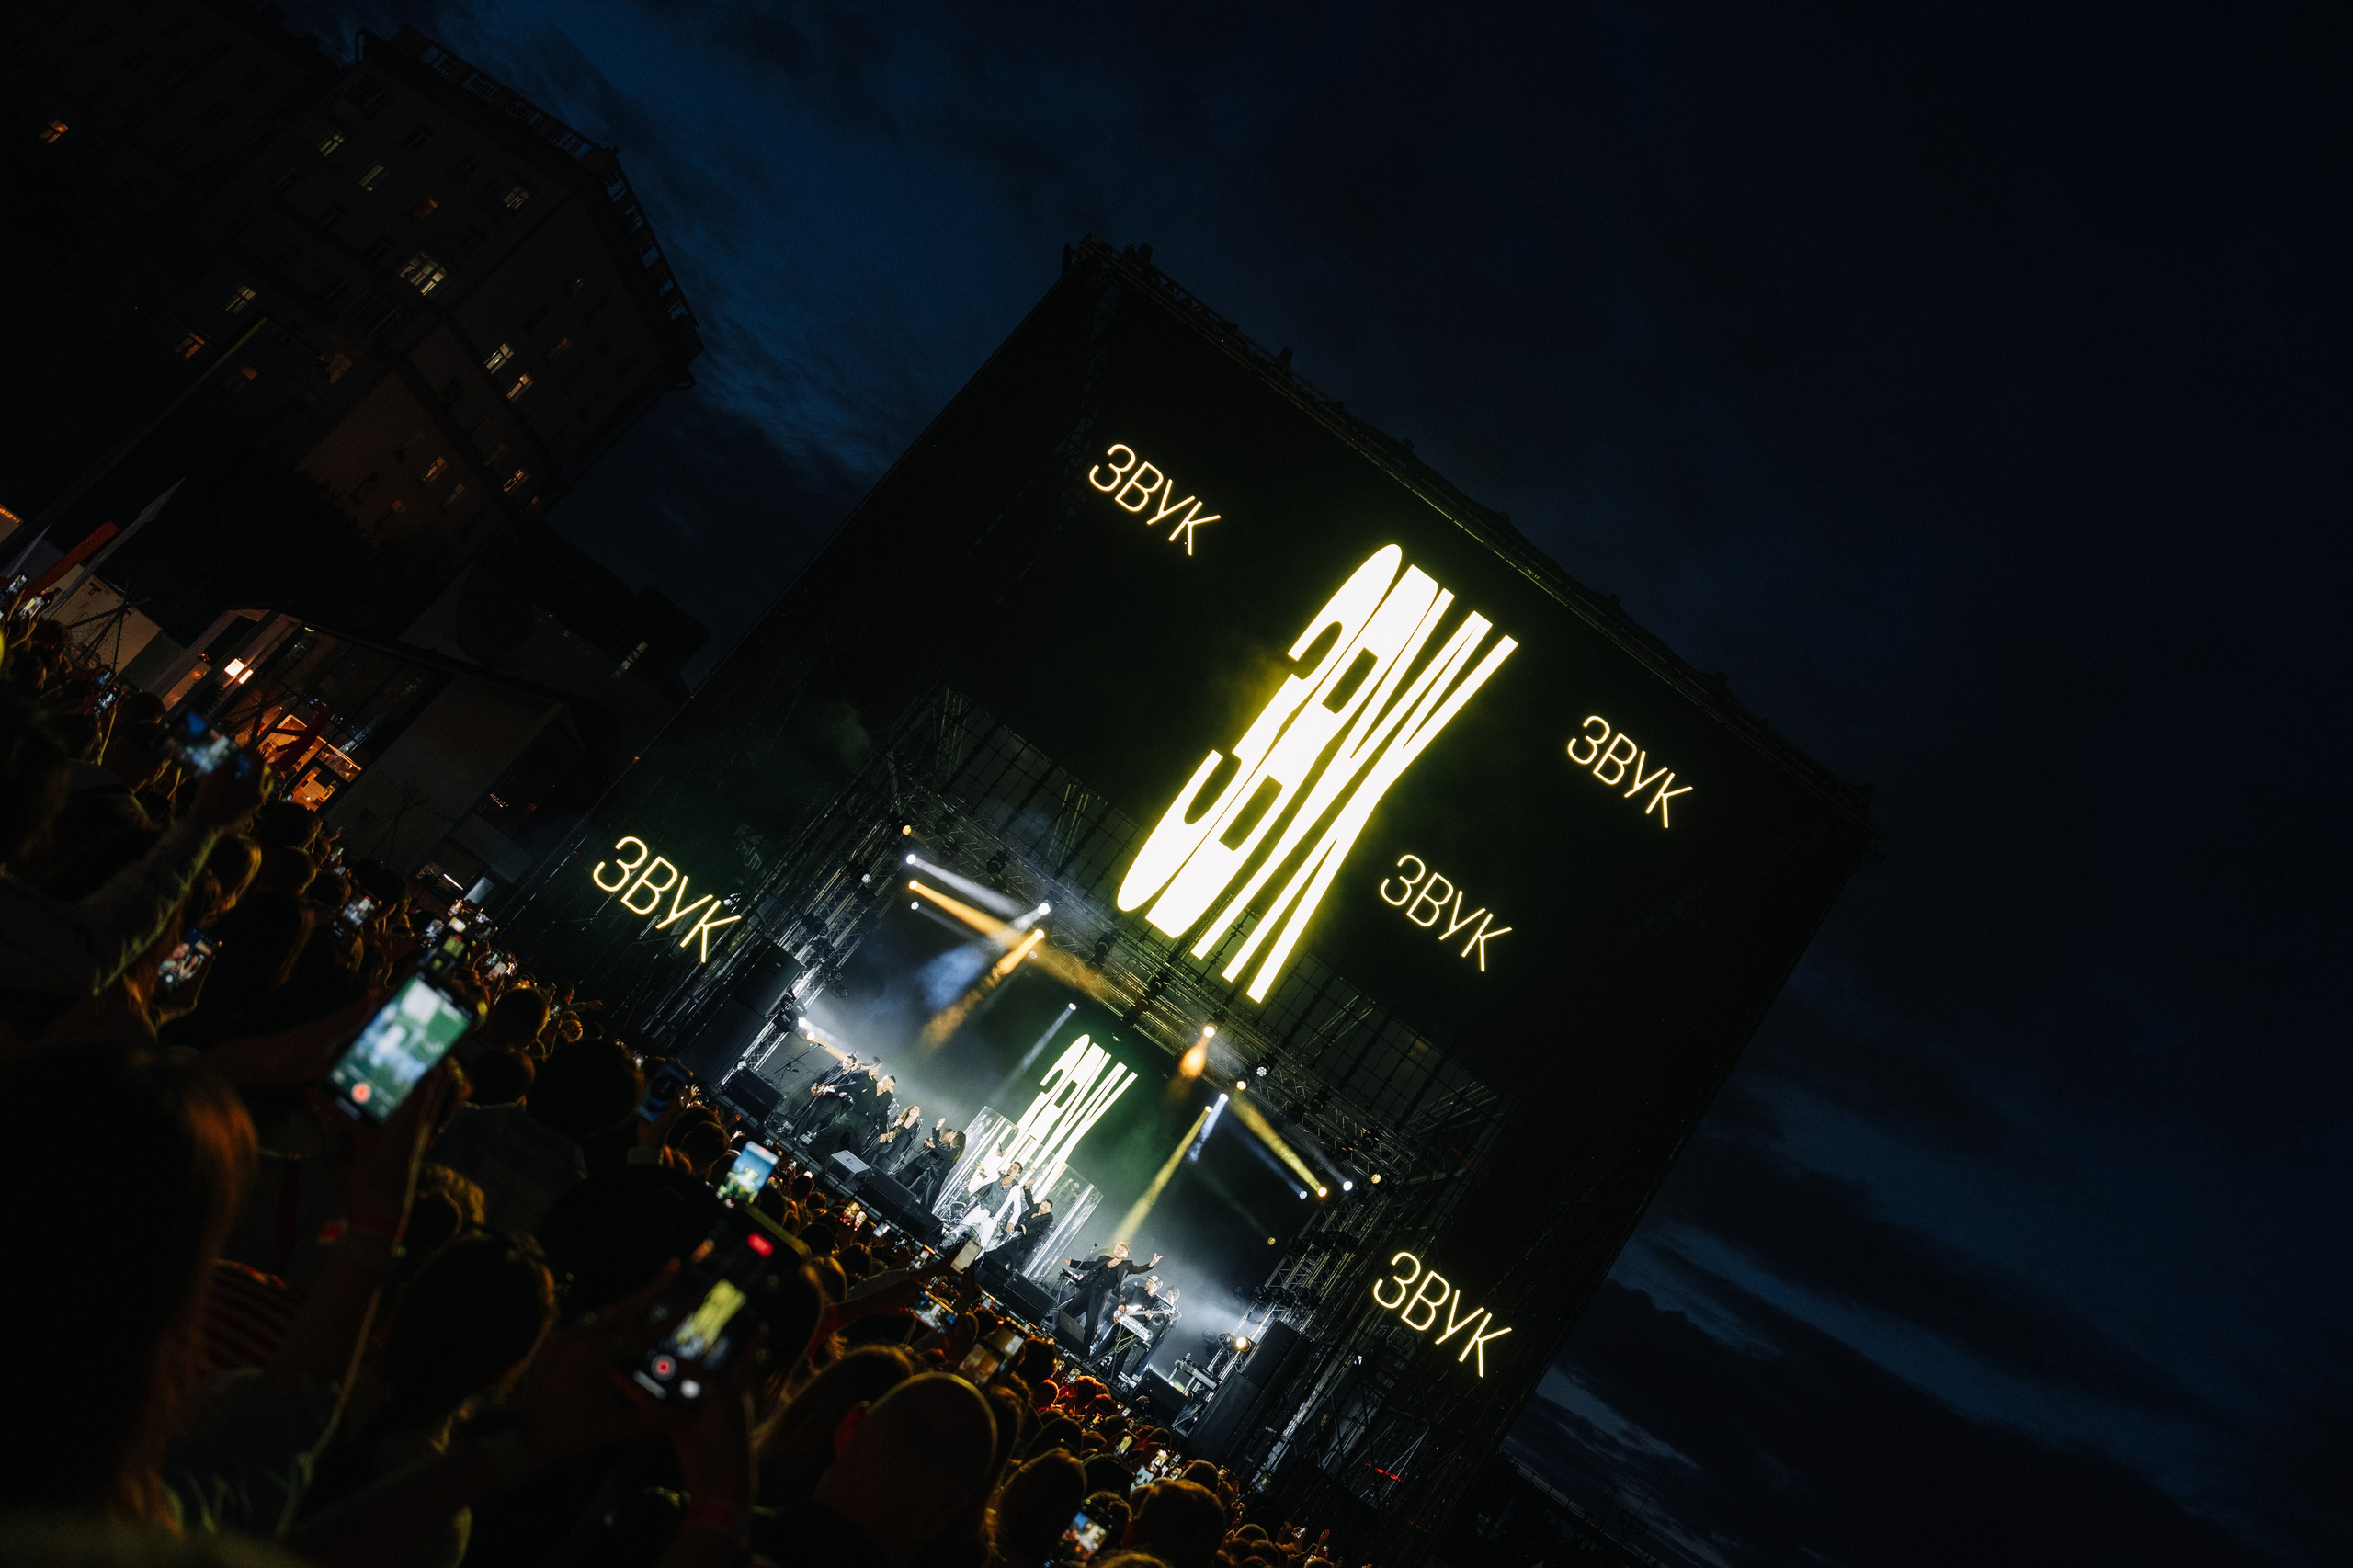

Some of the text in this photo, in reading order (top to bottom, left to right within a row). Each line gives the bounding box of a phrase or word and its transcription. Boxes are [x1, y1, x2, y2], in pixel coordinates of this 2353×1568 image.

[1089, 444, 1221, 556] ЗВУК
[1117, 544, 1518, 1004] ЗВУК
[1567, 716, 1693, 828] ЗВУК
[593, 836, 741, 963] ЗВУК
[1380, 855, 1512, 971] ЗВУК
[1373, 1252, 1512, 1378] ЗВУК
